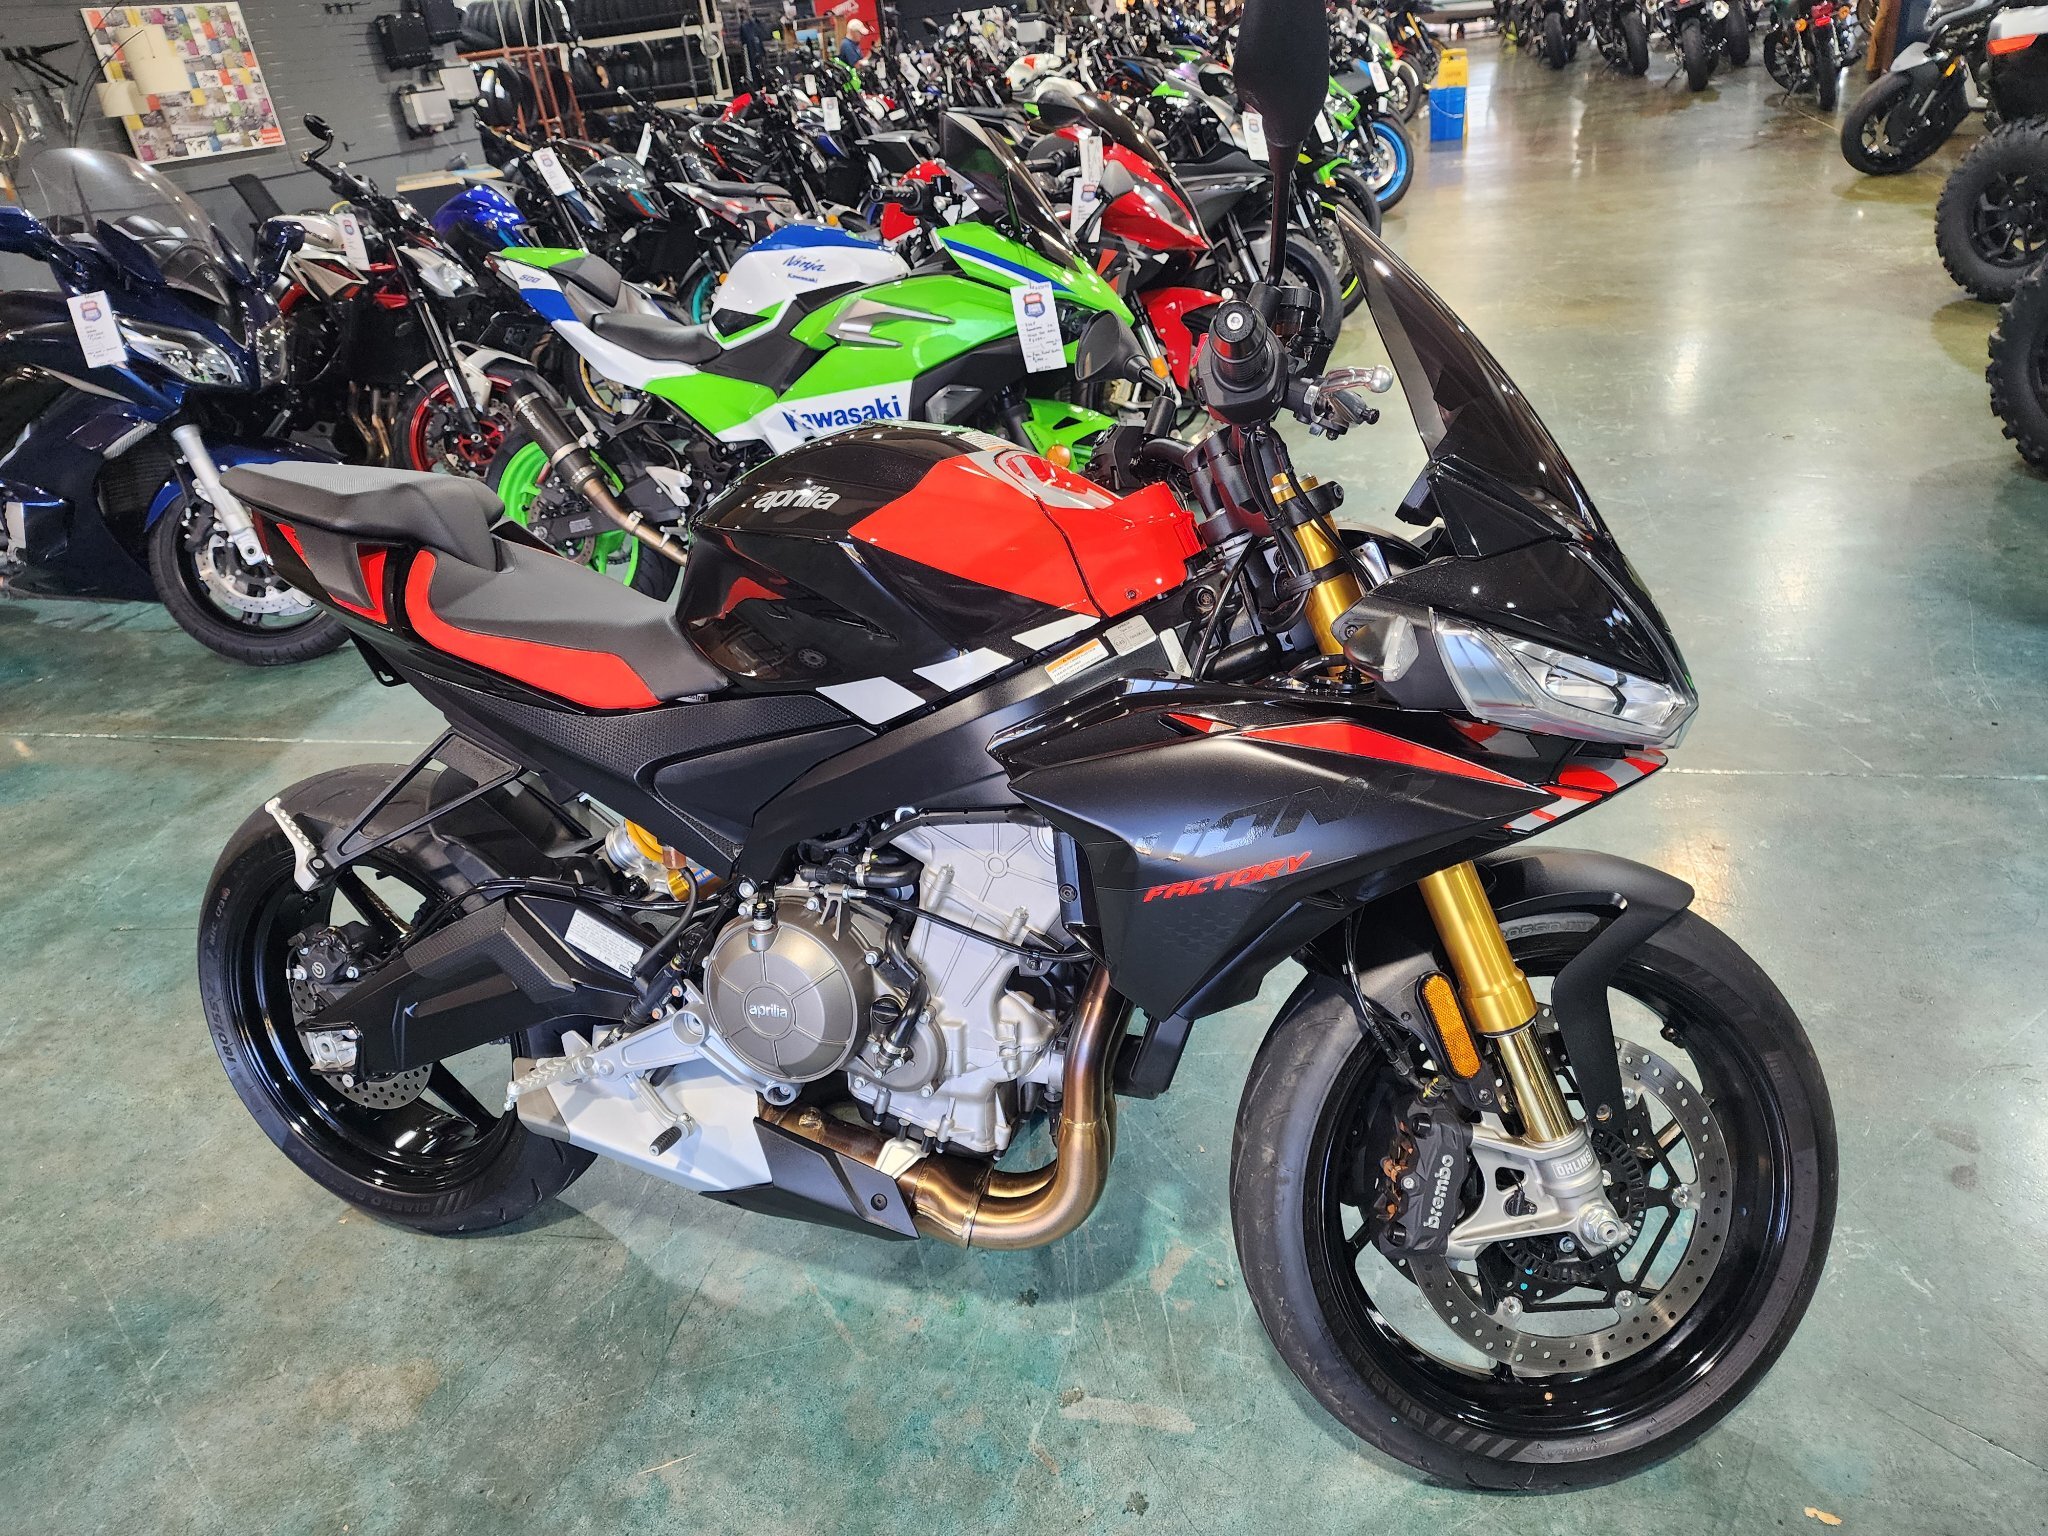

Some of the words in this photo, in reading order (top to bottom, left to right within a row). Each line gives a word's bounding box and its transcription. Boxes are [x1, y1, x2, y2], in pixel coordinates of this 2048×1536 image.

[782, 255, 826, 272] Ninja
[787, 272, 818, 283] Kawasaki
[782, 395, 903, 432] Kawasaki
[753, 485, 841, 512] aprilia
[1143, 850, 1312, 903] FACTORY
[749, 1003, 788, 1018] aprilia
[1556, 1149, 1594, 1176] ÖHLINS
[1423, 1154, 1454, 1229] brembo
